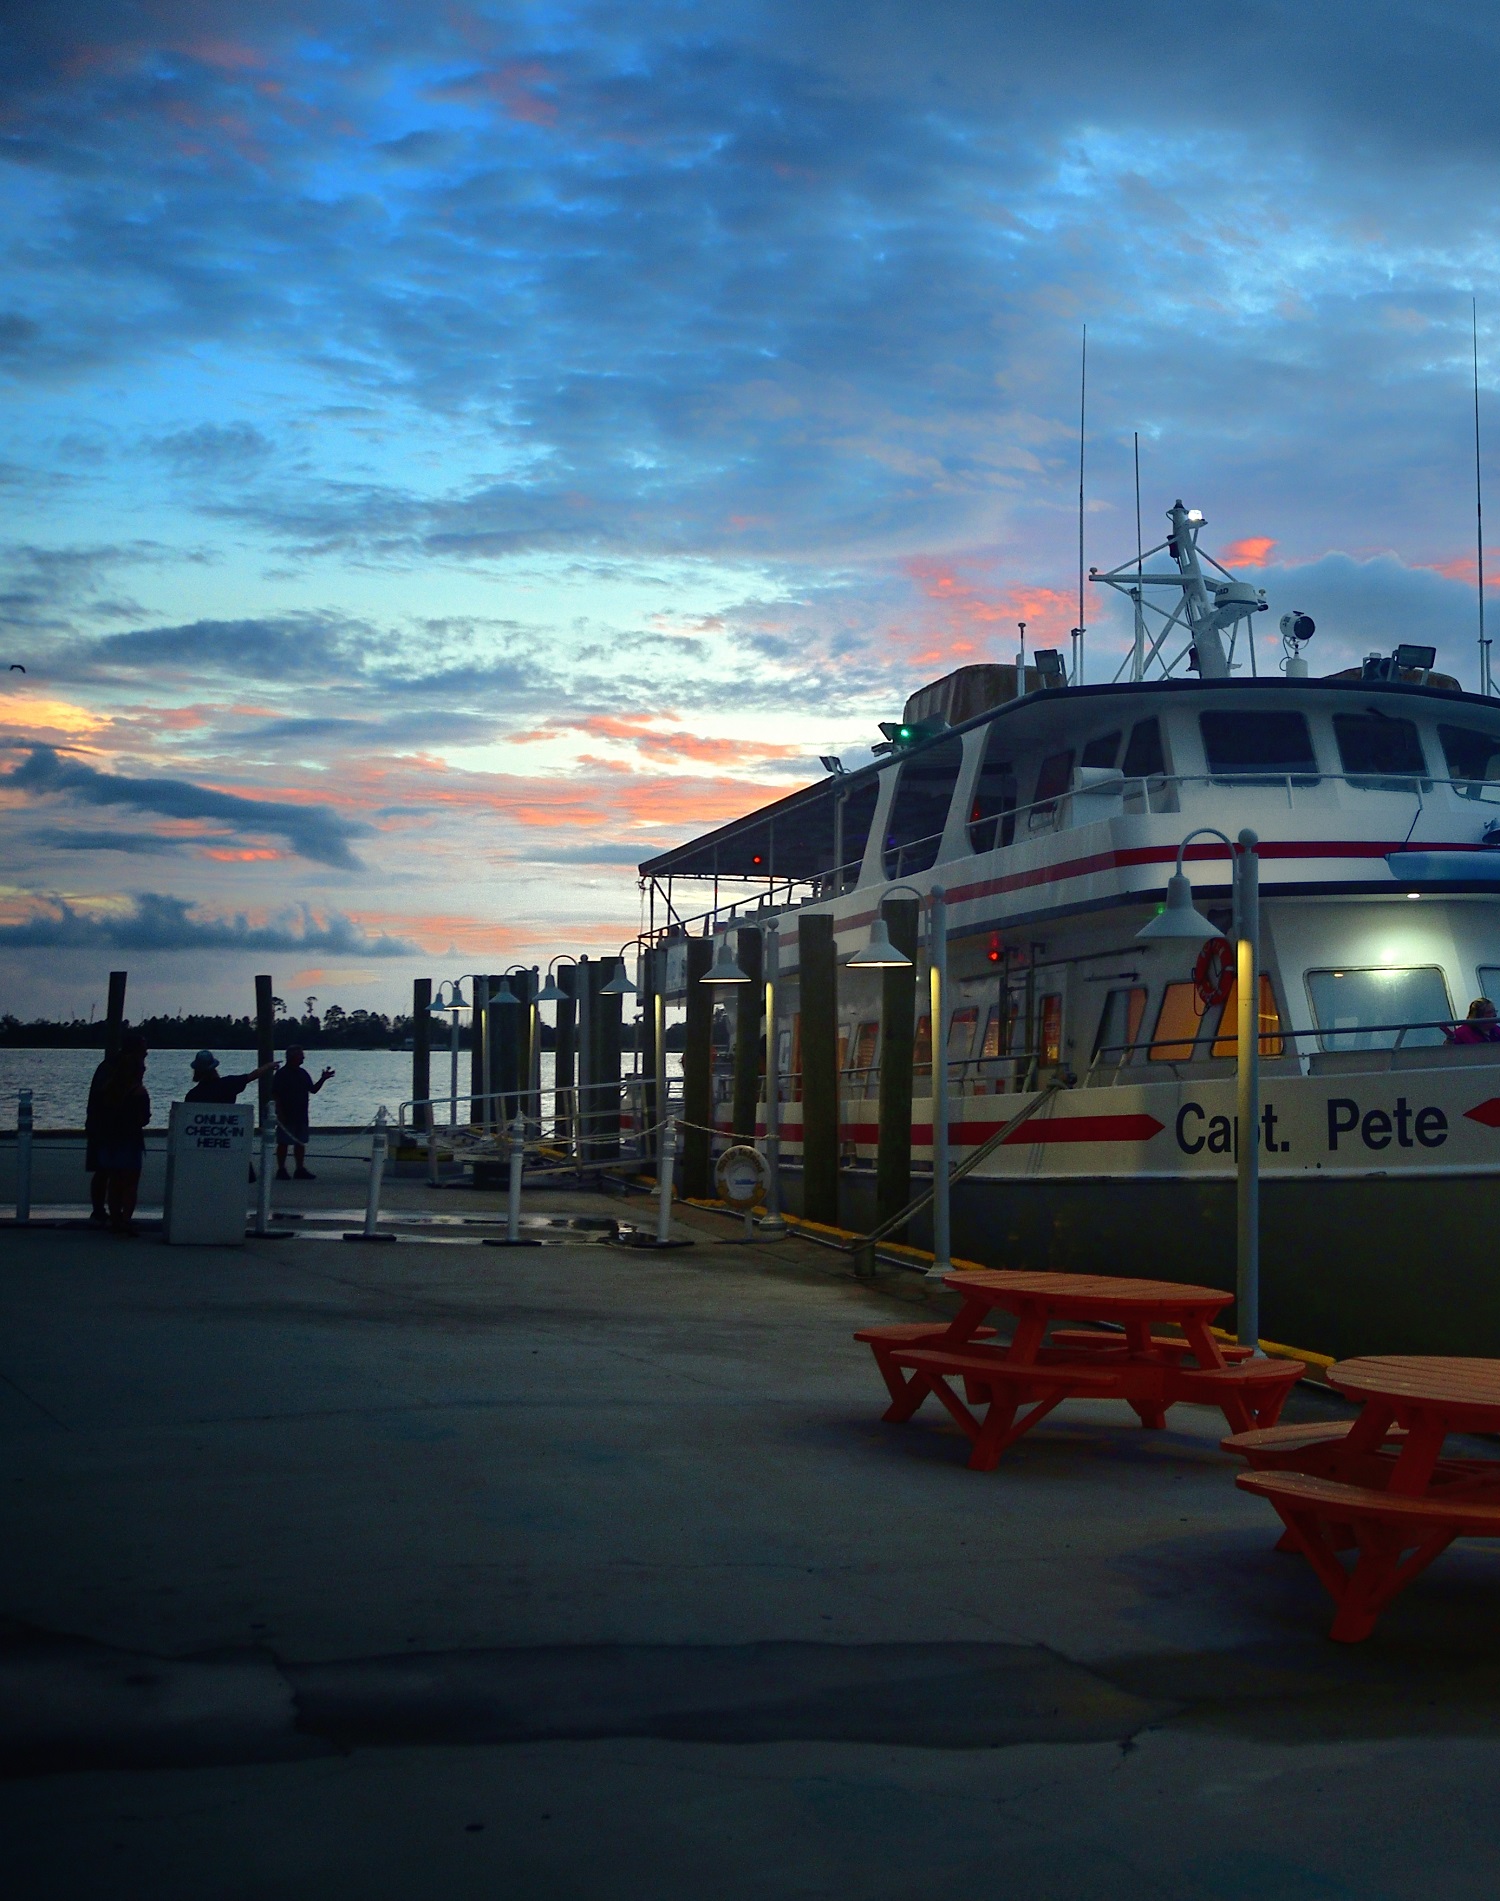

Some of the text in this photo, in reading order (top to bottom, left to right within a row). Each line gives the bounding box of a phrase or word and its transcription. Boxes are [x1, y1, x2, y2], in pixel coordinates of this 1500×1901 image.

[194, 1114, 239, 1125] ONLINE
[185, 1126, 244, 1137] CHECK-IN
[1175, 1097, 1449, 1164] Cat. Pete
[197, 1138, 231, 1148] HERE
